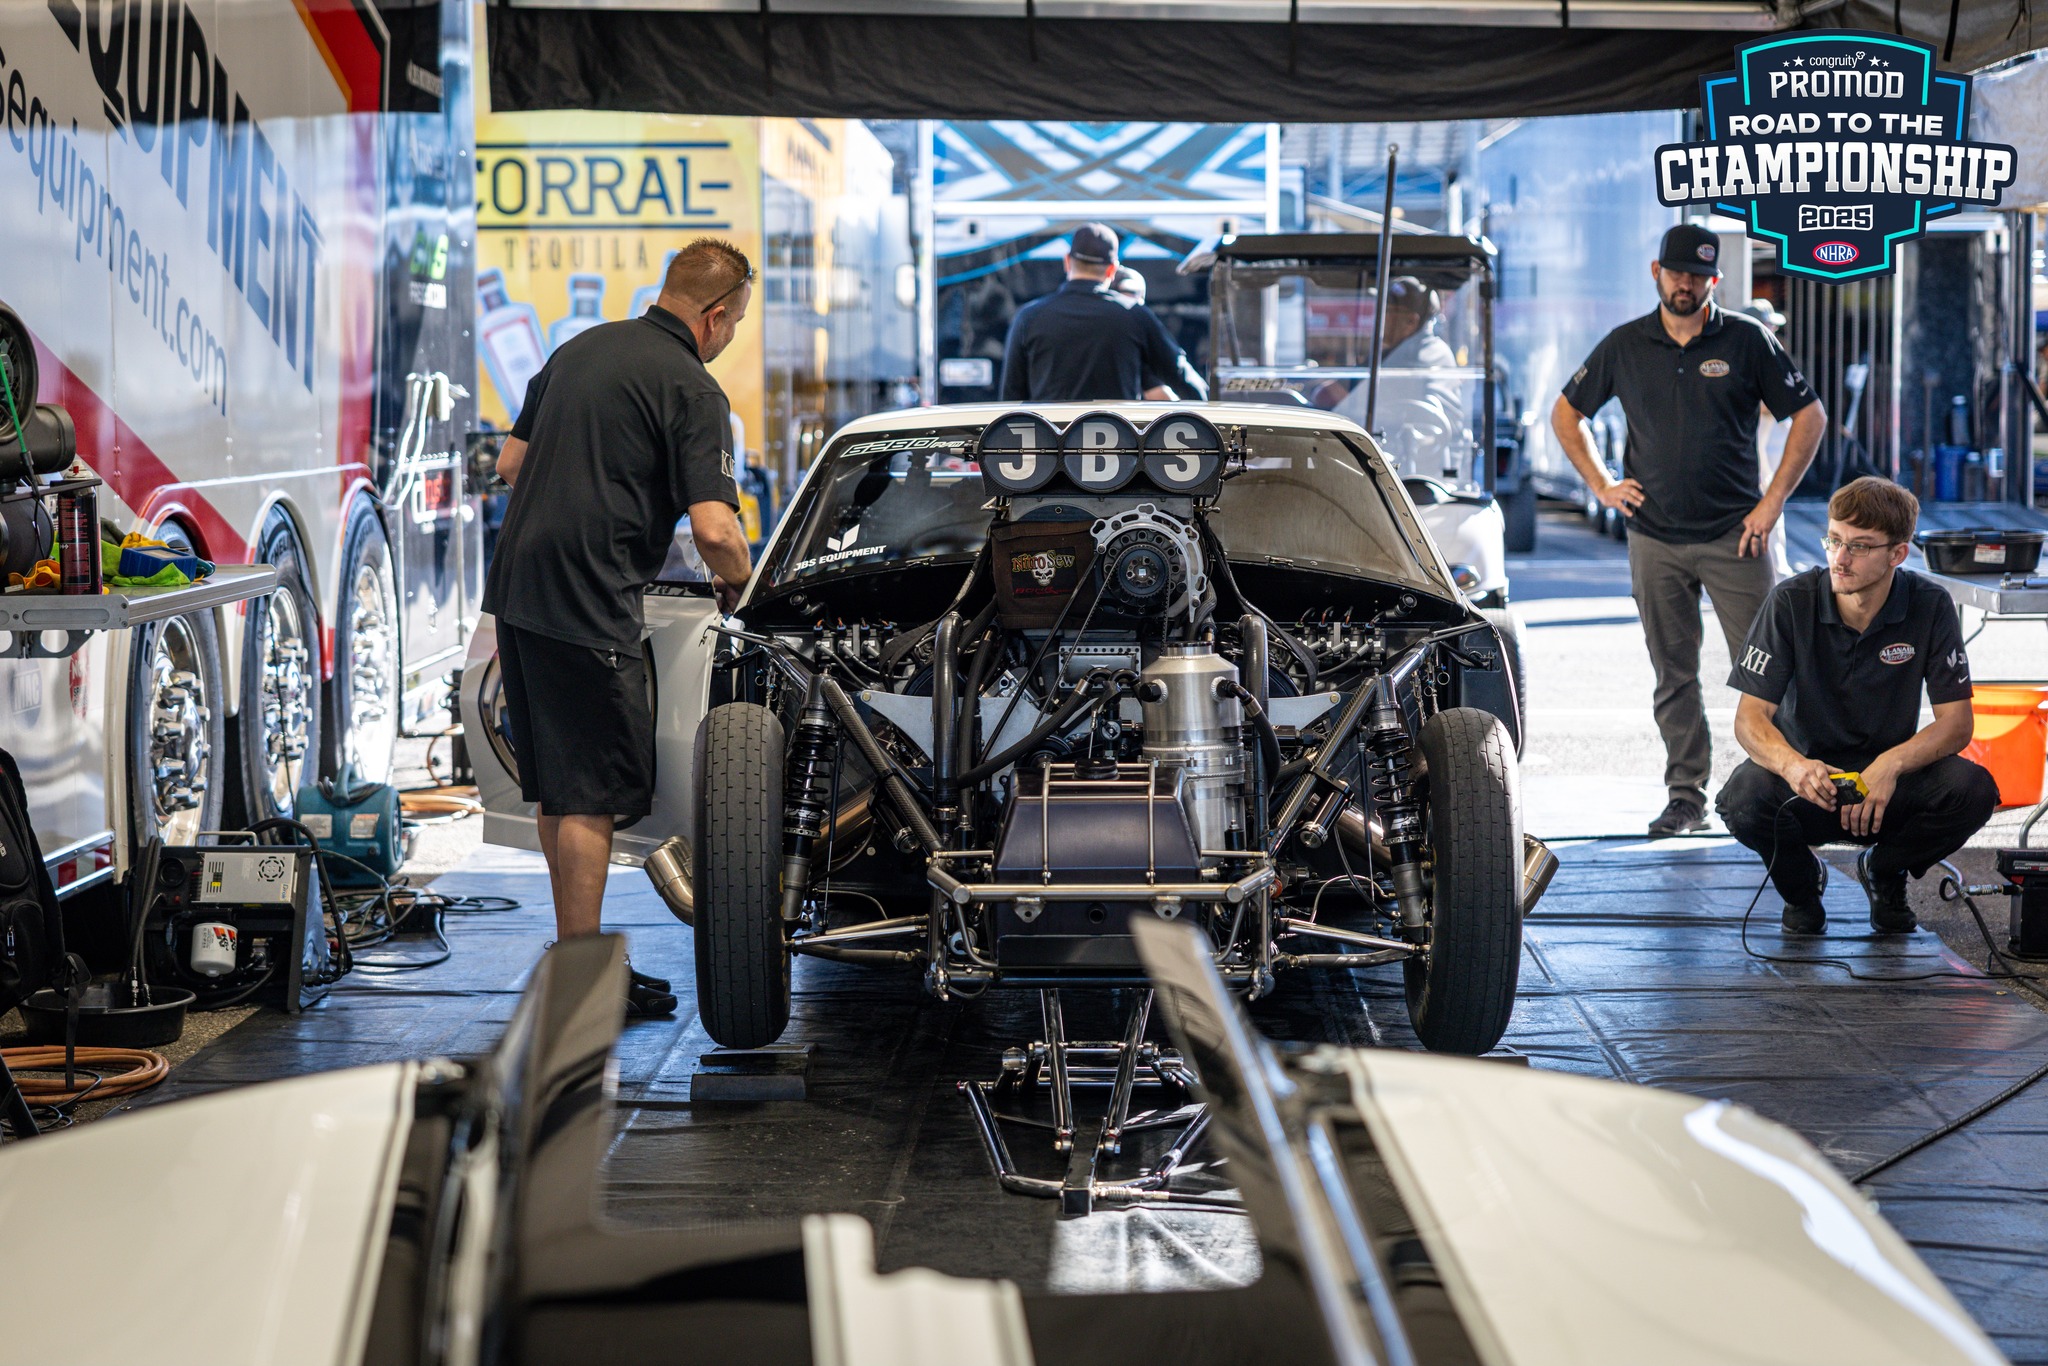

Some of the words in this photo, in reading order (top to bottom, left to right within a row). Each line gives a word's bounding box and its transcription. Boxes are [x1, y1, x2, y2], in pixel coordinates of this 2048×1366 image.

[0, 46, 227, 417] equipment.com
[504, 236, 650, 271] TEQUILA
[793, 558, 817, 572] JBS
[818, 545, 887, 564] EQUIPMENT
[1740, 645, 1773, 676] KH
